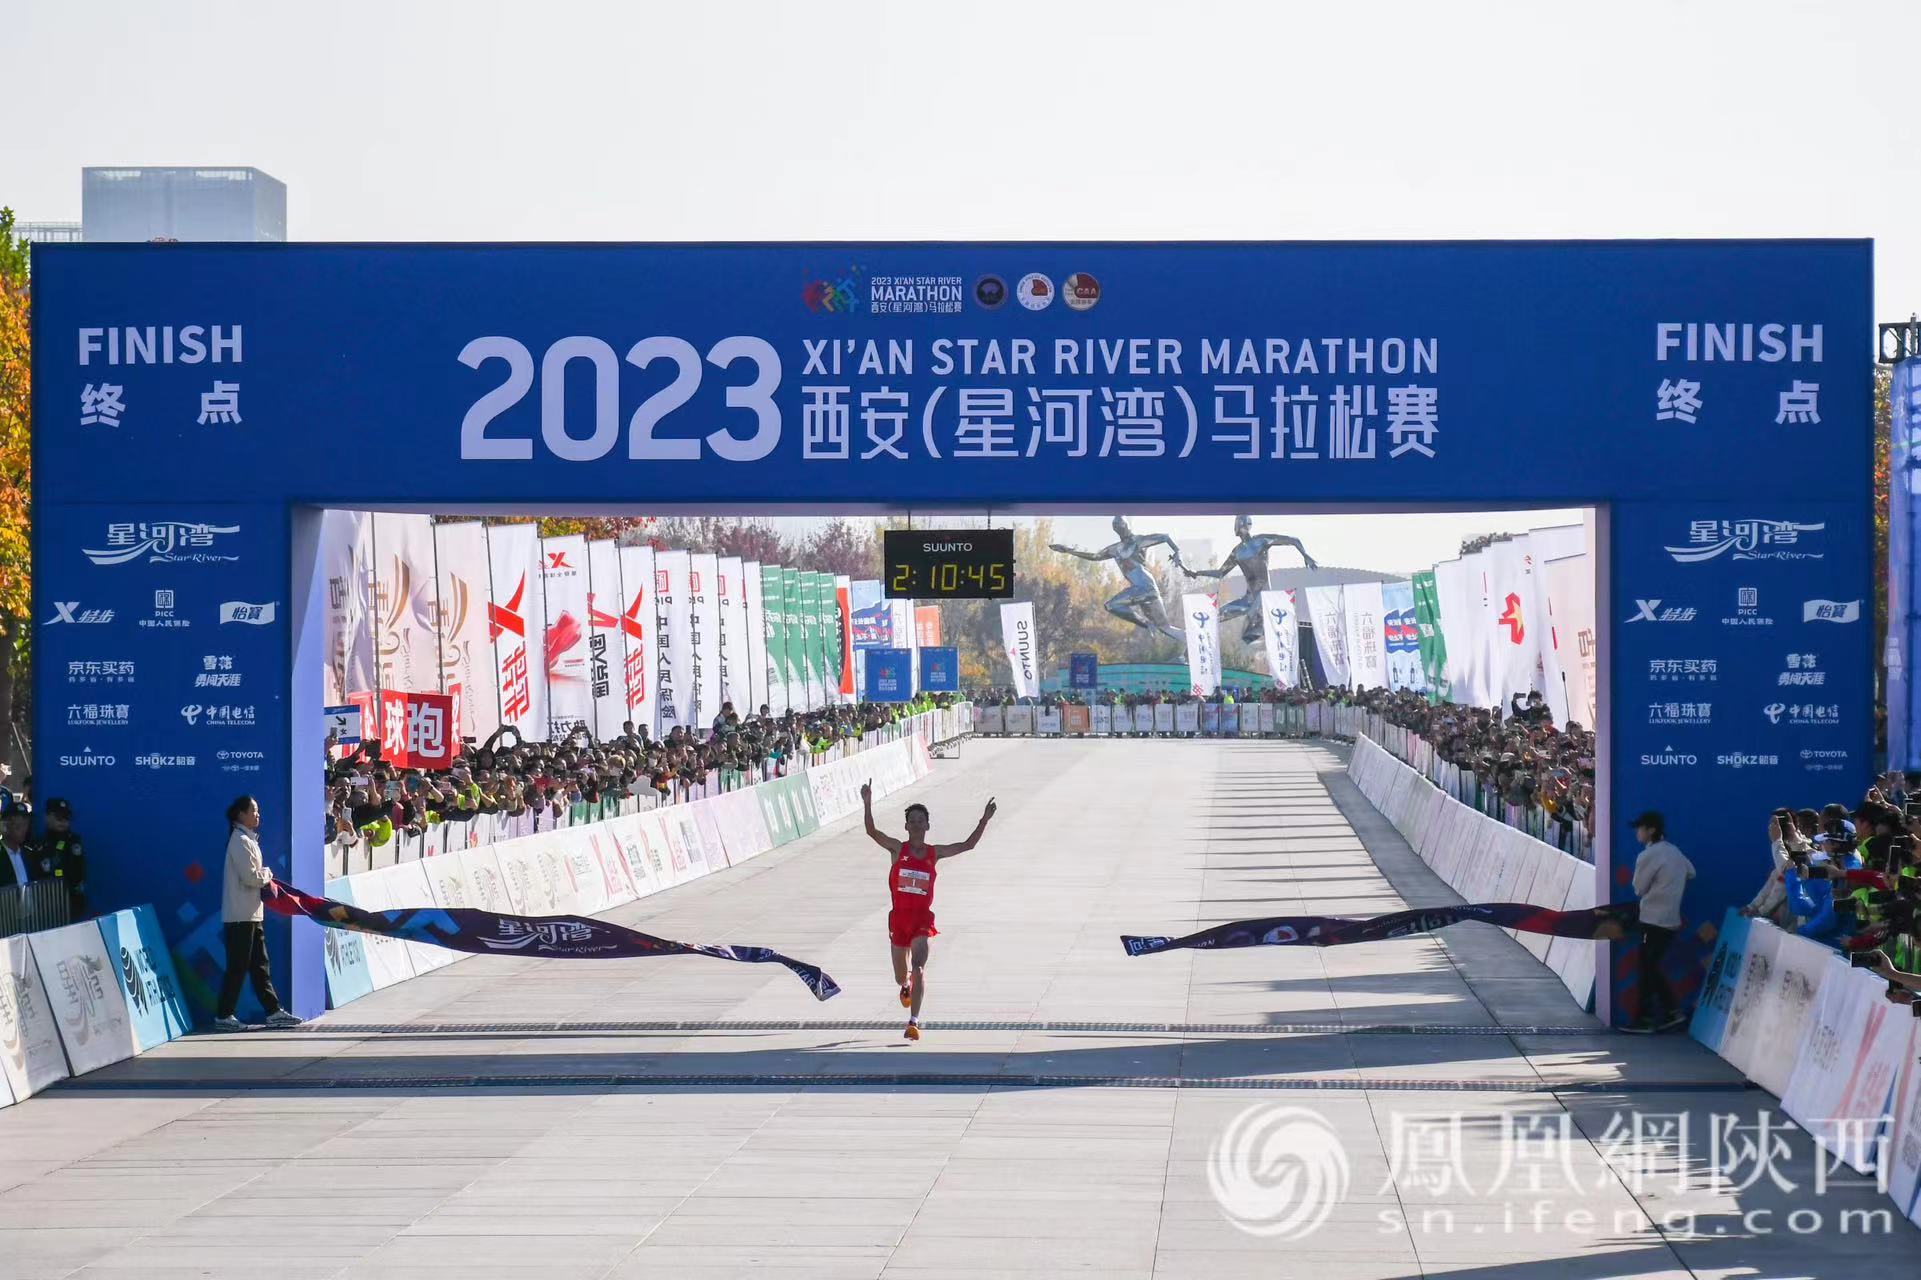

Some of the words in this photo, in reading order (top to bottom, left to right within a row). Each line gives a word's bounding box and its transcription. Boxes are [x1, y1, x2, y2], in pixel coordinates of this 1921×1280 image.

[871, 277, 892, 285] 2023
[916, 276, 936, 285] STAR
[938, 276, 962, 285] RIVER
[871, 286, 962, 301] MARATHON
[78, 324, 243, 366] FINISH
[1656, 322, 1823, 363] FINISH
[802, 339, 913, 375] XI'AN
[931, 338, 1036, 375] STAR
[1055, 338, 1183, 375] RIVER
[1201, 337, 1438, 374] MARATHON
[457, 335, 782, 462] 2023
[801, 384, 1440, 460] 西安(星河湾)马拉松赛
[107, 522, 214, 553] 星河湾
[1690, 520, 1800, 551] 星河湾
[923, 542, 973, 552] SUUNTO
[893, 563, 1006, 591] 2:10:45
[68, 661, 135, 675] 京东买药
[203, 655, 233, 670] 雪花
[1650, 659, 1717, 673] 京东买药
[1787, 653, 1816, 669] 雪花
[206, 705, 255, 720] 中国电信
[1789, 703, 1839, 719] 中国电信
[60, 756, 115, 766] SUUNTO
[1641, 754, 1697, 765] SUUNTO
